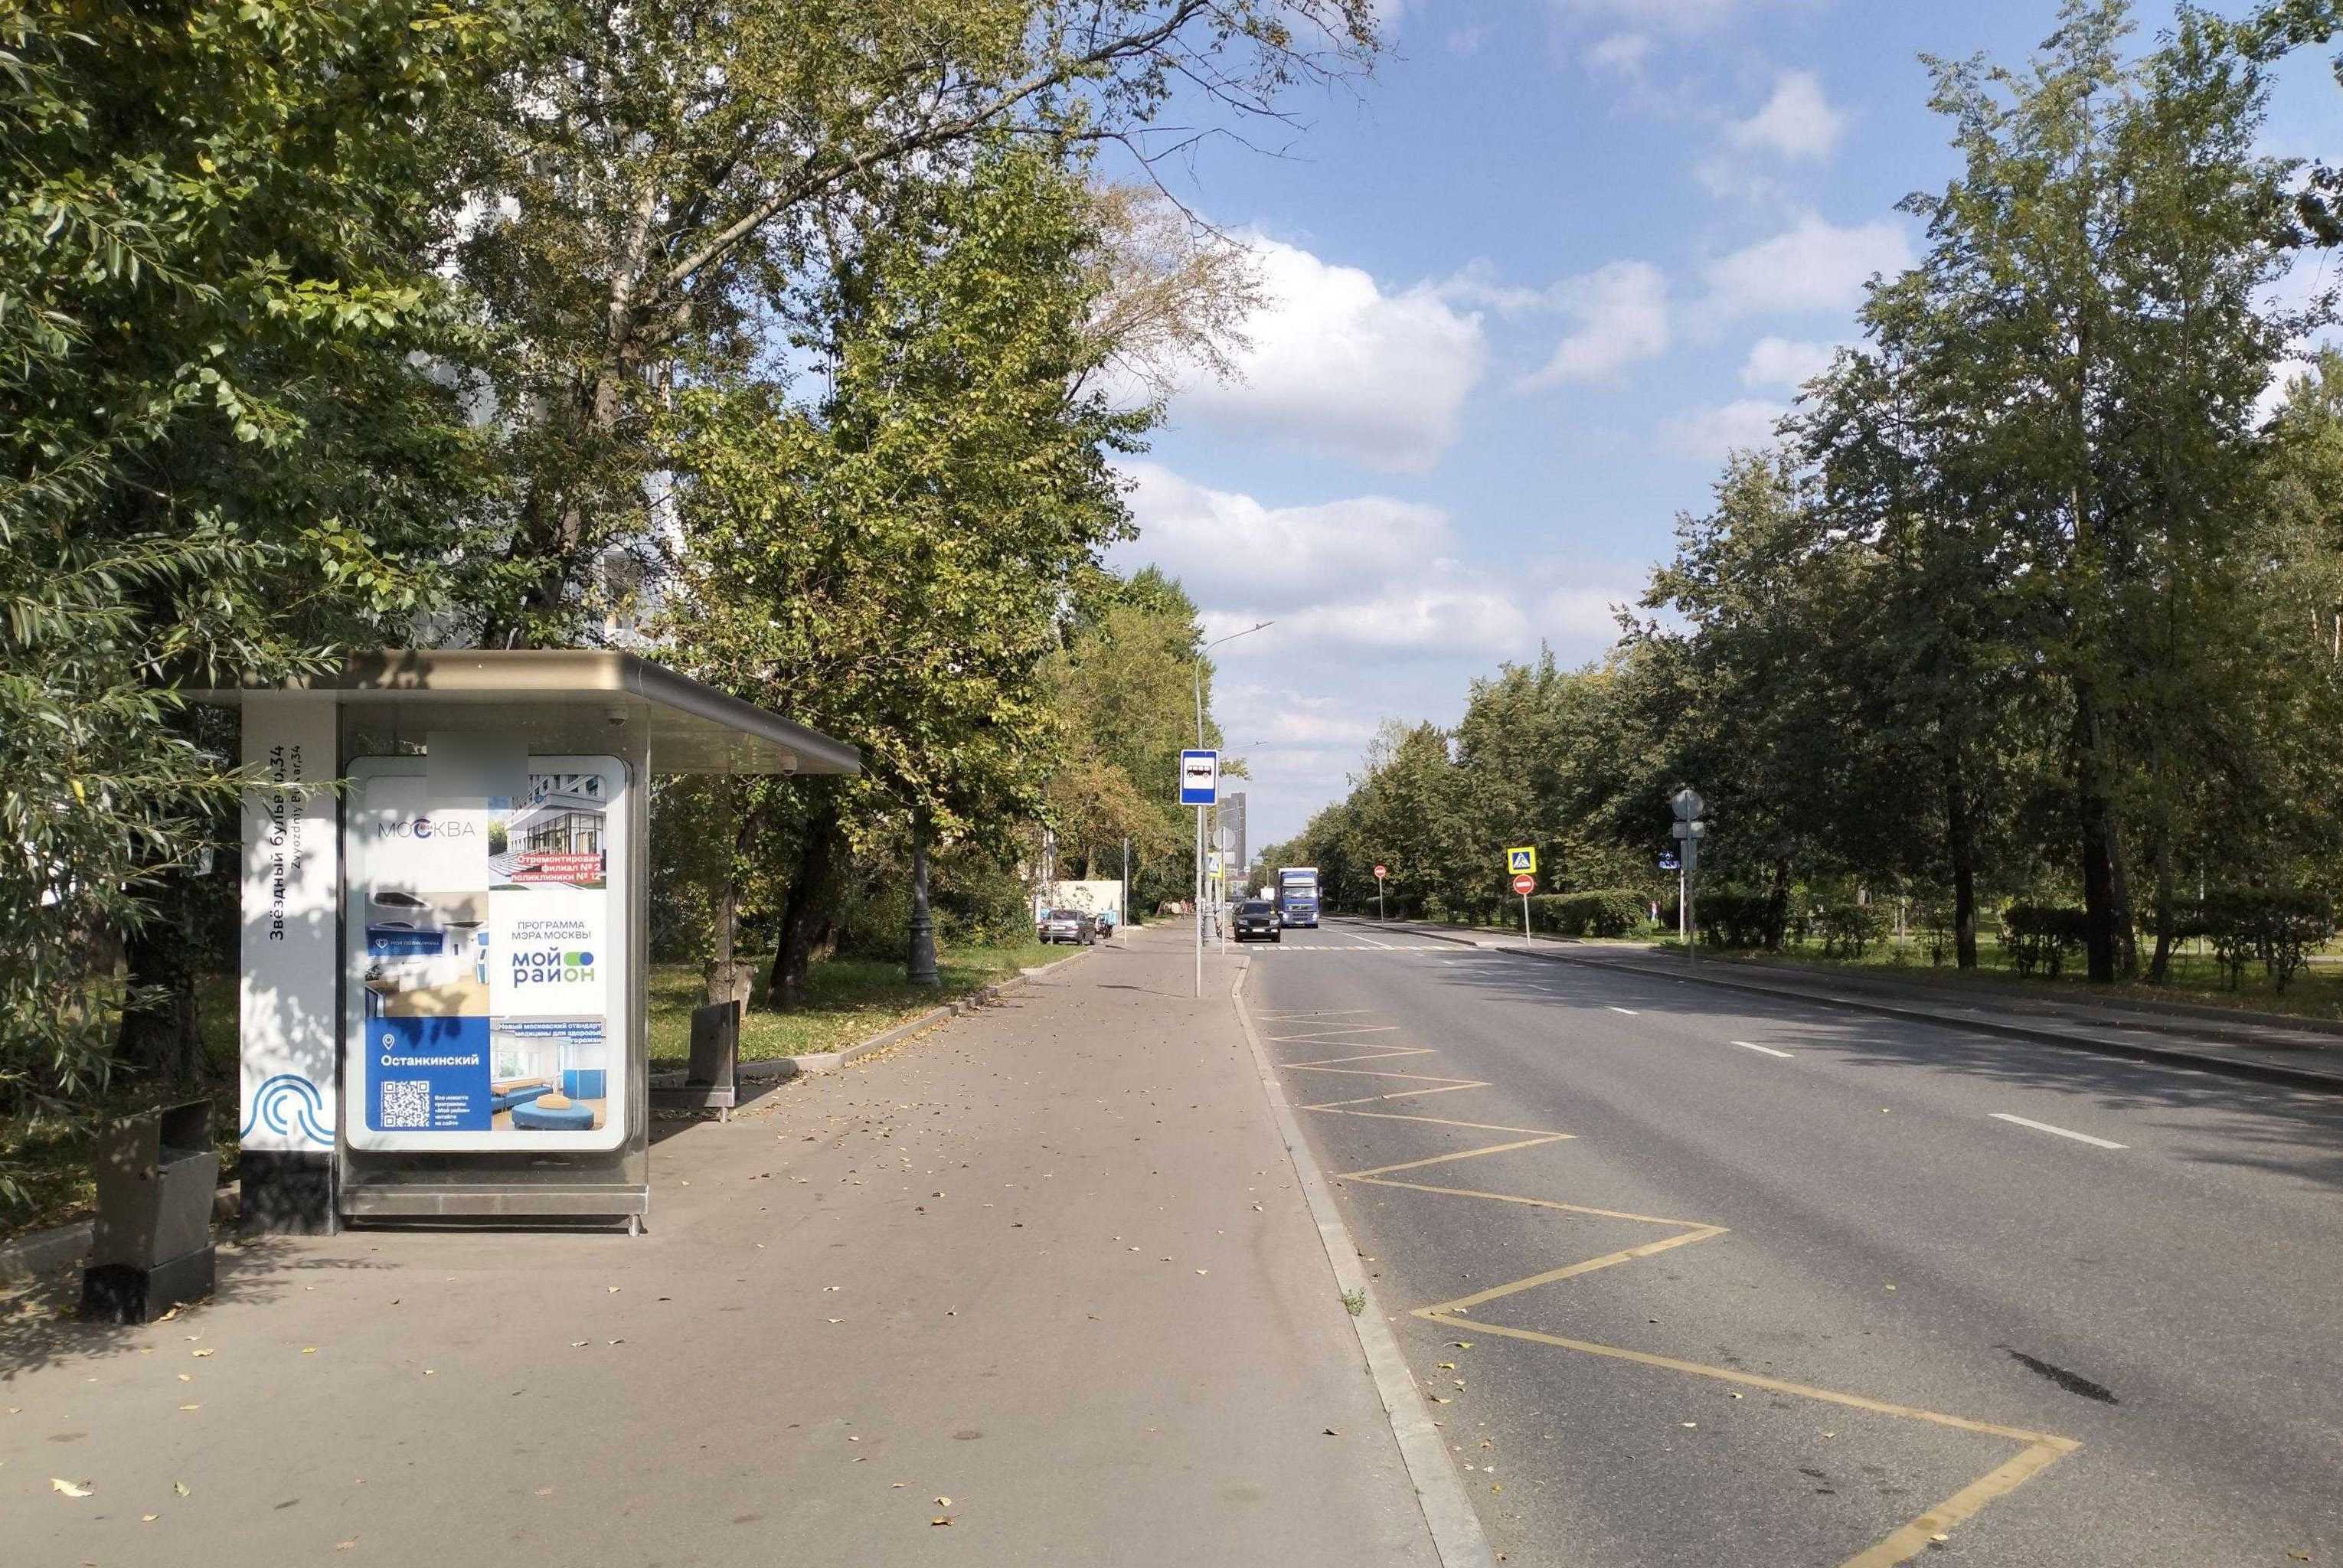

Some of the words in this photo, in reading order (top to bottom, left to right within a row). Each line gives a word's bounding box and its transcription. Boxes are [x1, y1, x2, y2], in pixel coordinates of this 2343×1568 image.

[269, 745, 287, 846] бульвр,34
[377, 818, 476, 839] МОСКВА
[291, 806, 304, 869] Zvyozdniy
[541, 863, 579, 872] филиал
[590, 872, 601, 880] 12
[269, 852, 286, 941] Звёздный
[518, 921, 585, 929] ПРОГРАММА
[511, 931, 542, 940] МЭРА
[544, 930, 591, 939] МОСКВЫ
[512, 946, 561, 966] мой
[381, 1054, 479, 1067] Останкинский
